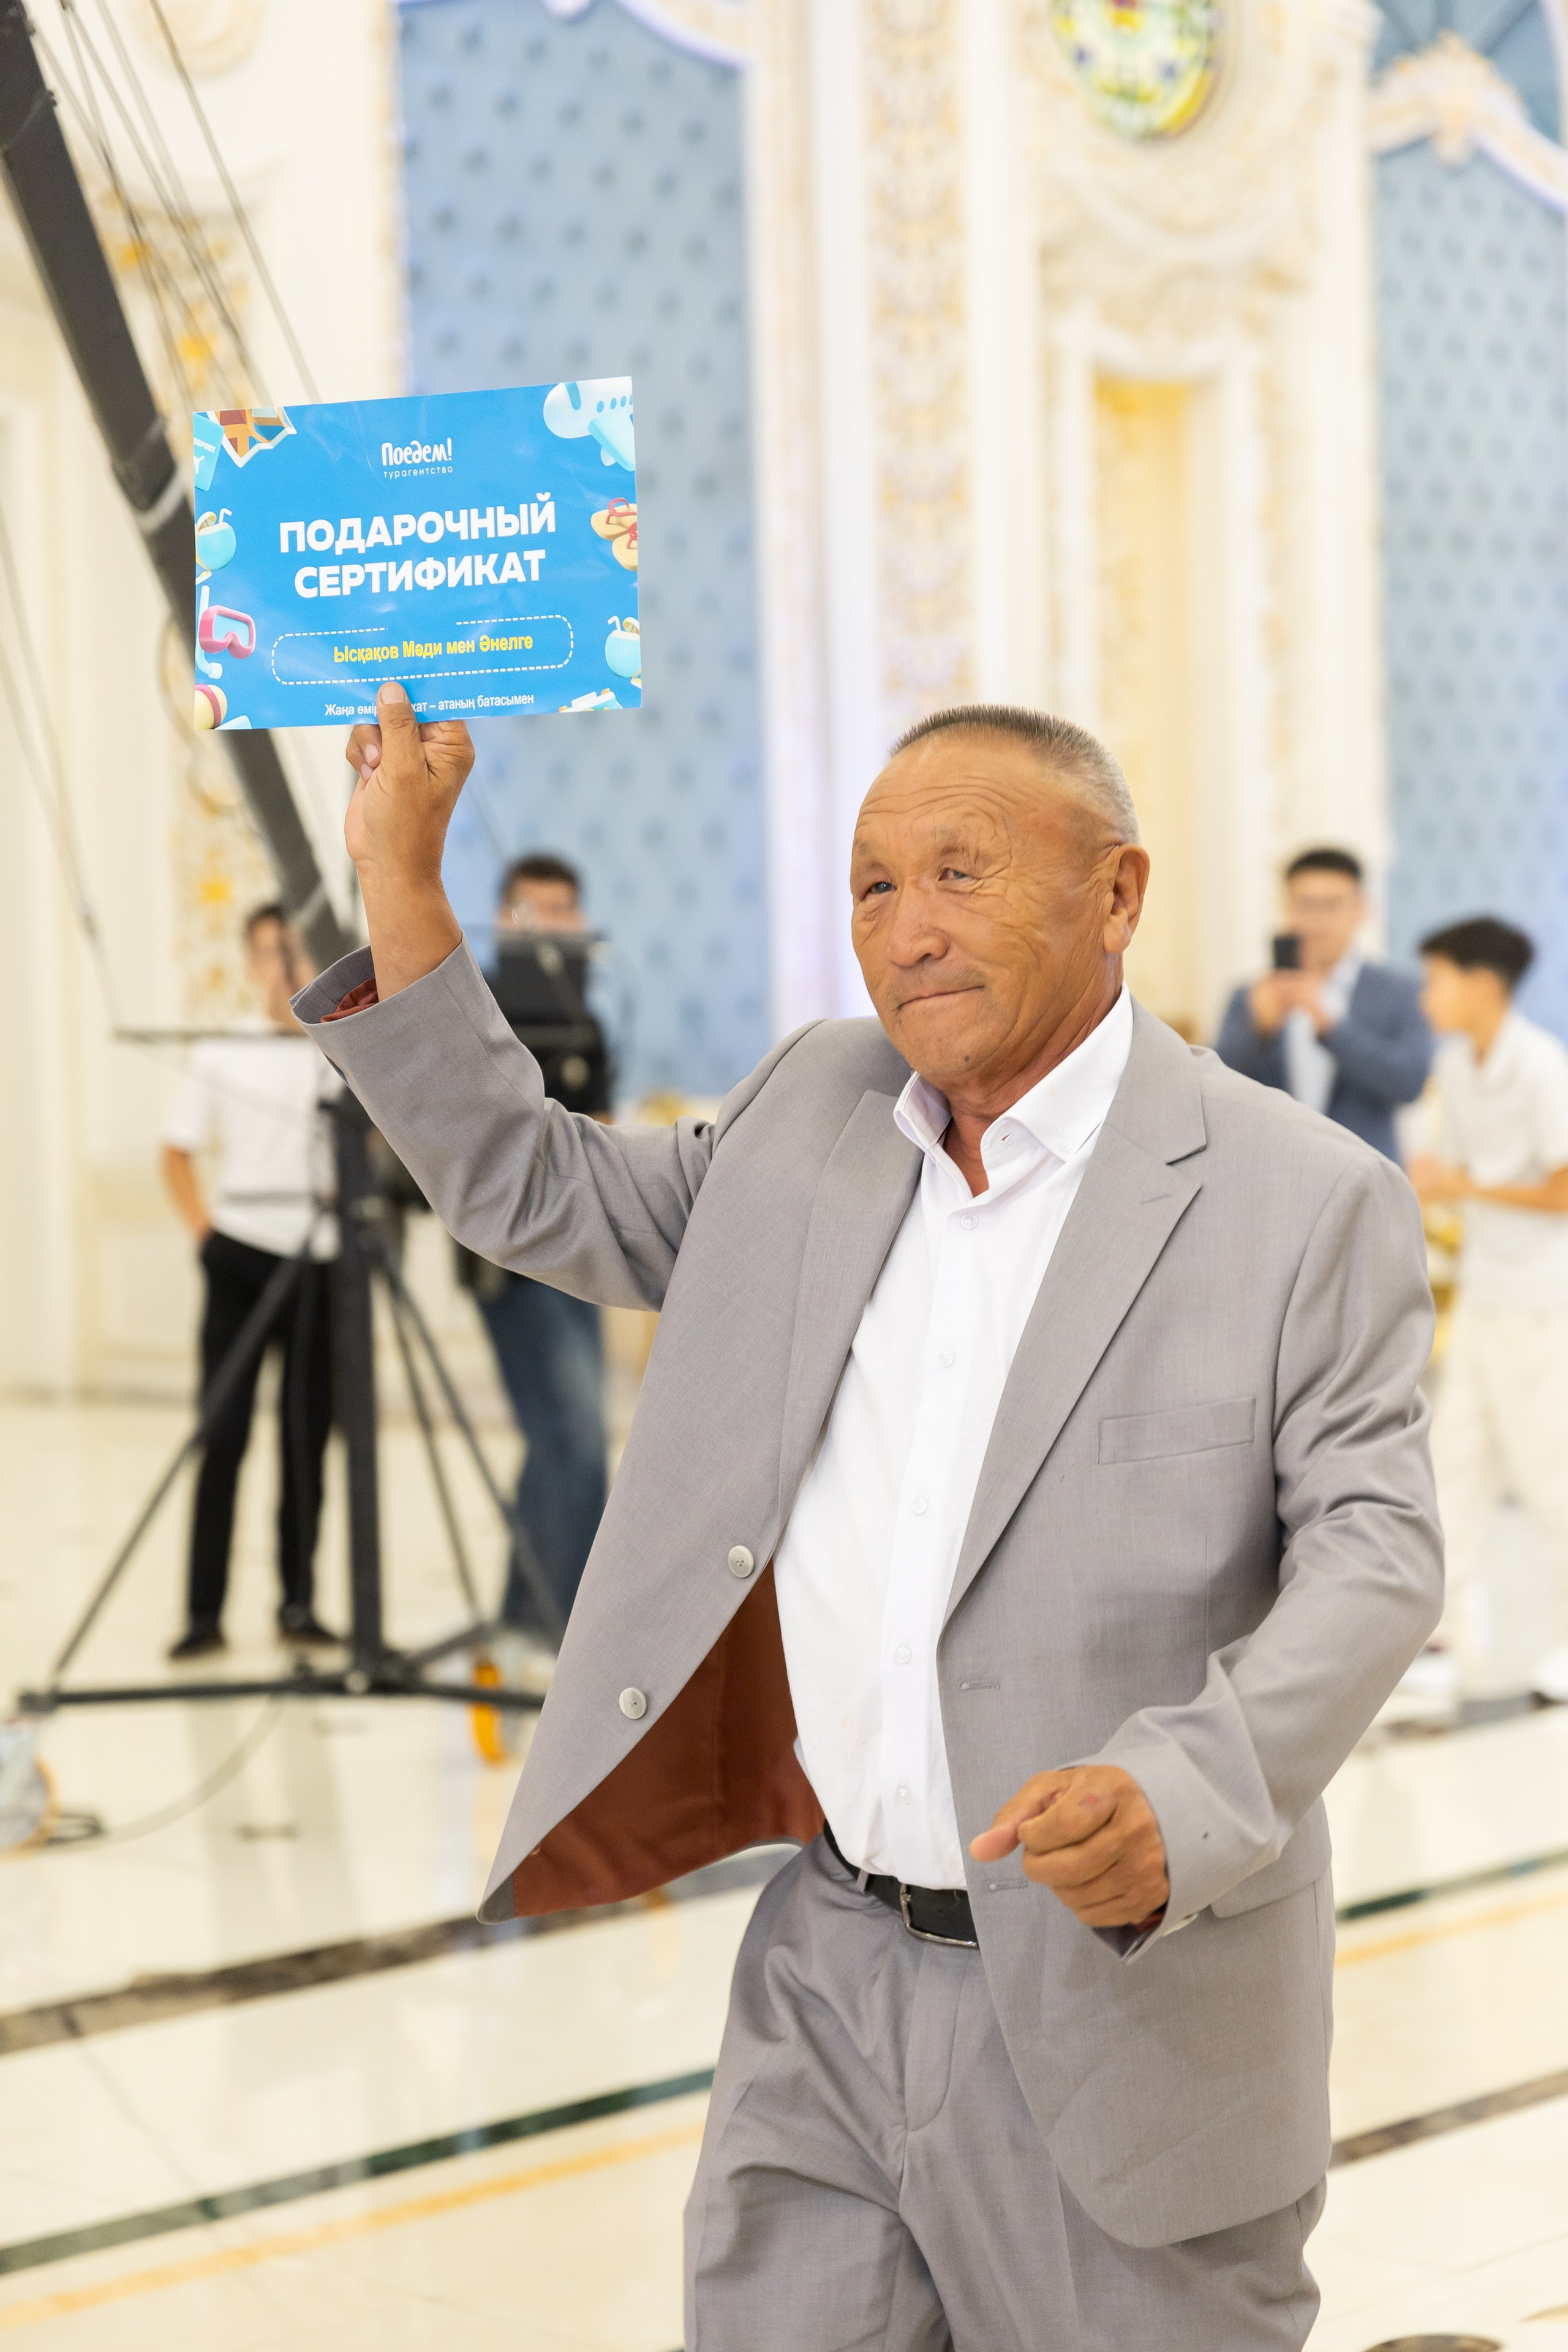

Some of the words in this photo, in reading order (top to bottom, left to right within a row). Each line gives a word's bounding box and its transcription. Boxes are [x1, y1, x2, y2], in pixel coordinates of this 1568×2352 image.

[382, 437, 452, 466] Поедем!
[383, 466, 453, 480] турагентство
[279, 492, 556, 556] ПОДАРОЧНЫЙ
[294, 549, 546, 598] СЕРТИФИКАТ
[334, 646, 399, 664] Ысқақов
[402, 640, 442, 659] Мәди
[447, 639, 475, 654] мен
[479, 635, 533, 652] Әнелге
[325, 704, 355, 717] Жаңа
[438, 698, 475, 710] атаның
[477, 694, 534, 707] батасымен
